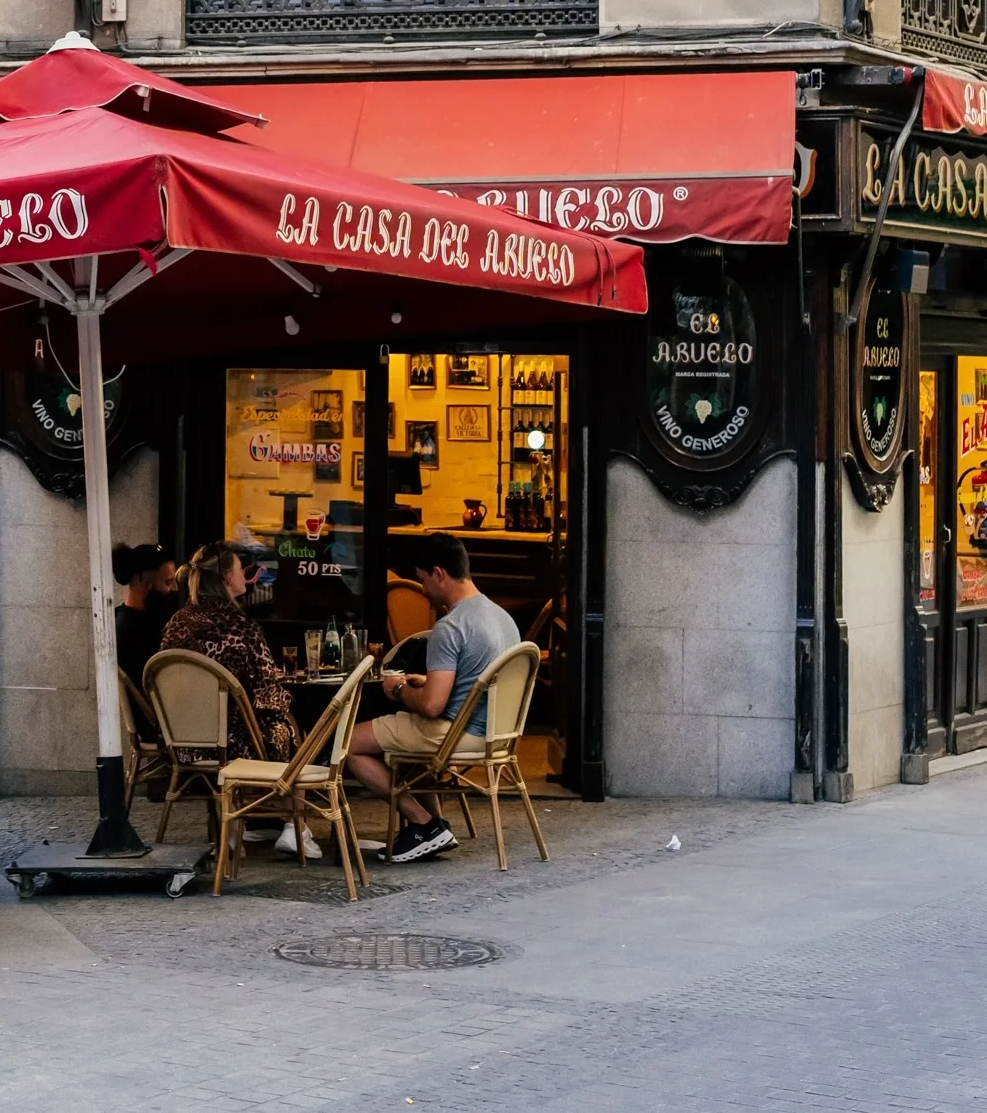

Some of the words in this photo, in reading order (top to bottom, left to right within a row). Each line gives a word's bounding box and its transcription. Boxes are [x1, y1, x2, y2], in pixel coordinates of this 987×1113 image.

[276, 193, 320, 246] LA
[333, 201, 411, 259] CASA
[419, 218, 469, 269] DEL
[480, 229, 575, 287] ABUELO
[690, 312, 720, 334] EL
[876, 317, 889, 339] EL
[652, 341, 754, 364] ABUELO
[863, 345, 900, 367] ABUELO
[961, 393, 975, 406] VINO
[32, 398, 55, 430] VINO
[656, 405, 682, 438] VINO
[681, 405, 751, 451] GENEROSO
[870, 407, 897, 453] GENEROSO
[249, 431, 342, 463] GAMBAS
[278, 540, 316, 558] Chato
[297, 561, 319, 576] 50
[321, 564, 342, 576] PTS
